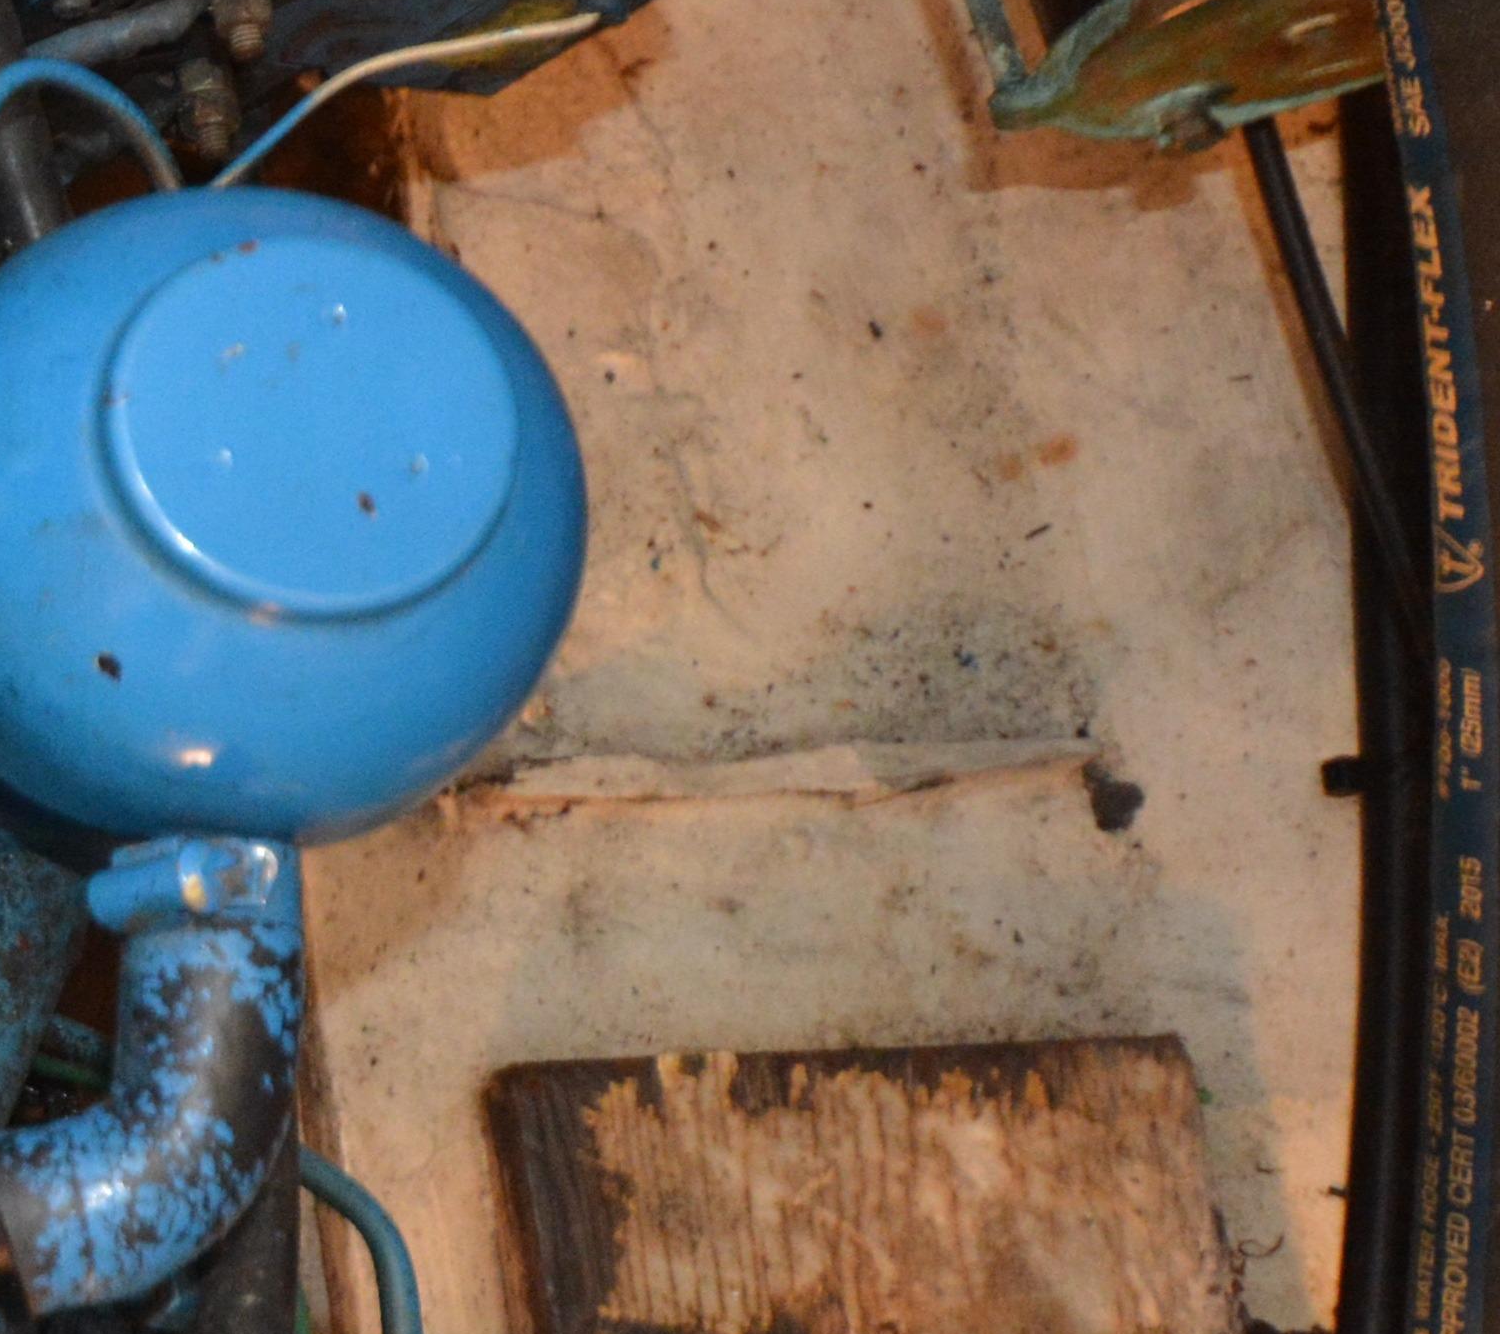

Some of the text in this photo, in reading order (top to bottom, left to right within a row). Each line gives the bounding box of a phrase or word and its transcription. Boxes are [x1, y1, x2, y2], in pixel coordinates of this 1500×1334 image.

[1400, 79, 1432, 136] SAE
[1407, 187, 1466, 519] TRIDENT-FLEX
[1459, 857, 1484, 920] 2015
[1457, 940, 1484, 993] (E2)
[1422, 1155, 1440, 1227] HOSE
[1449, 1130, 1474, 1207] CERT
[1415, 1232, 1437, 1319] WATER
